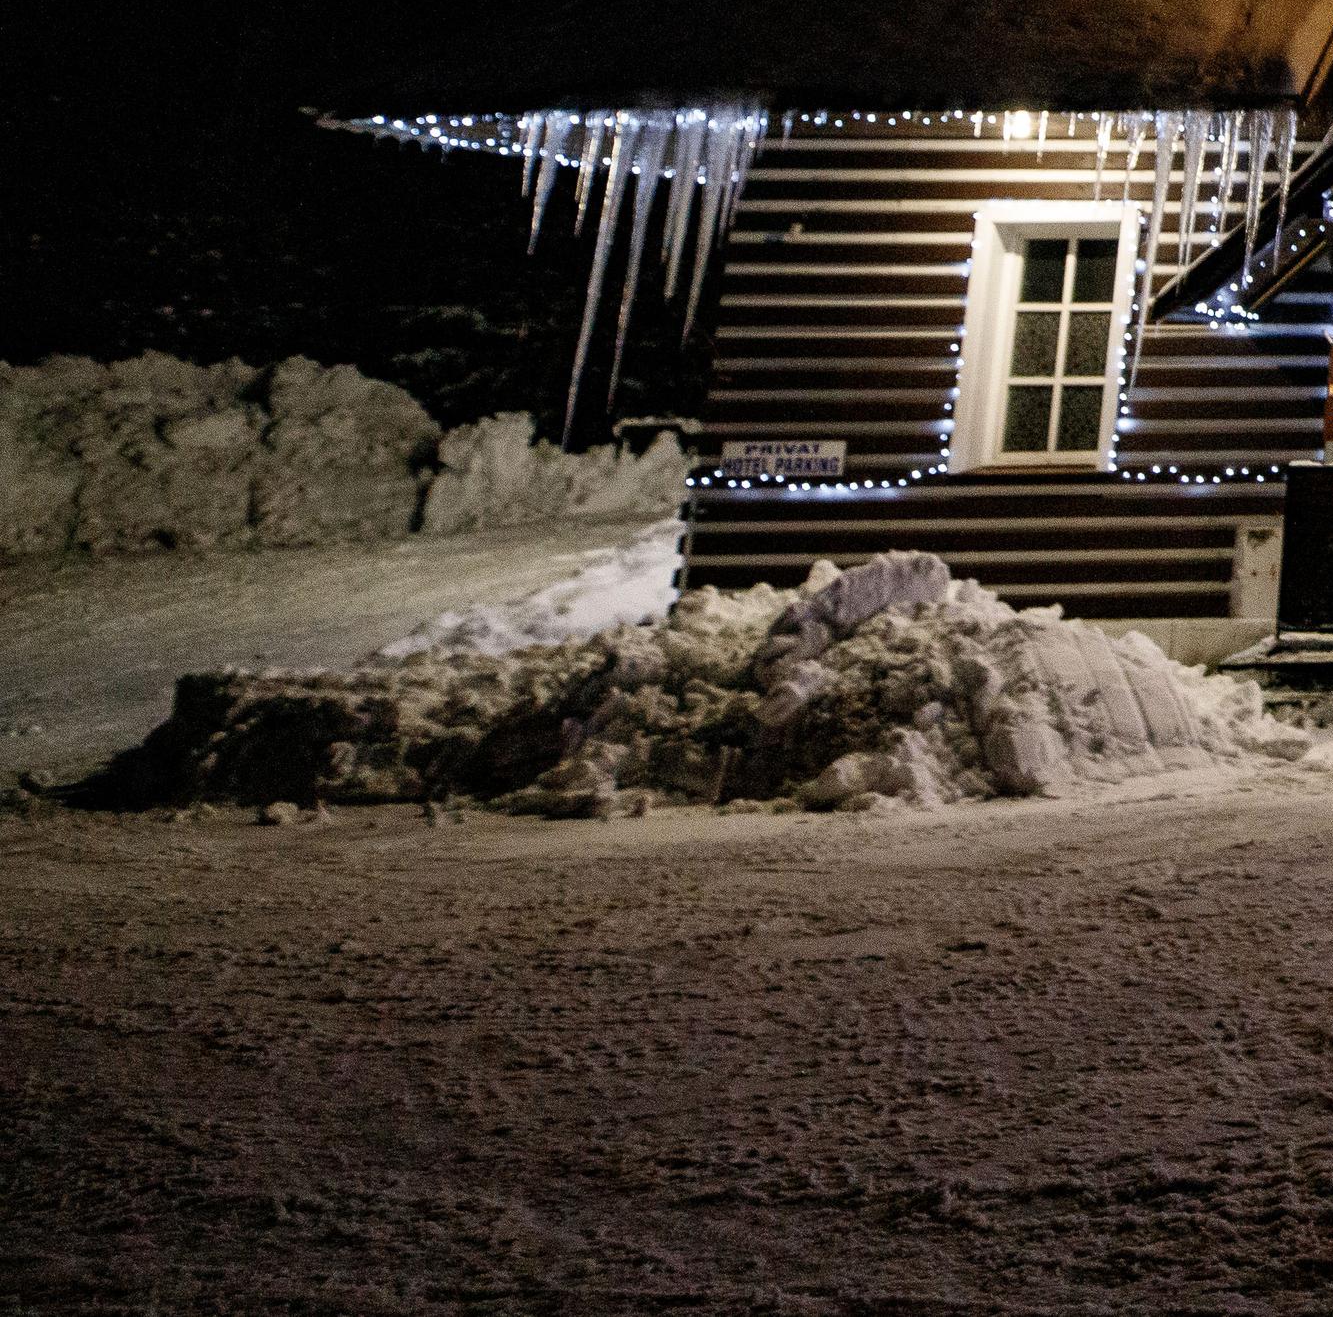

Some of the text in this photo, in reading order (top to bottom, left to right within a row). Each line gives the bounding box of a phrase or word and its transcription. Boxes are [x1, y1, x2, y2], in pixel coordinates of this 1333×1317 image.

[744, 443, 822, 455] PRIVAT
[722, 456, 840, 474] HOTEL PARKING
